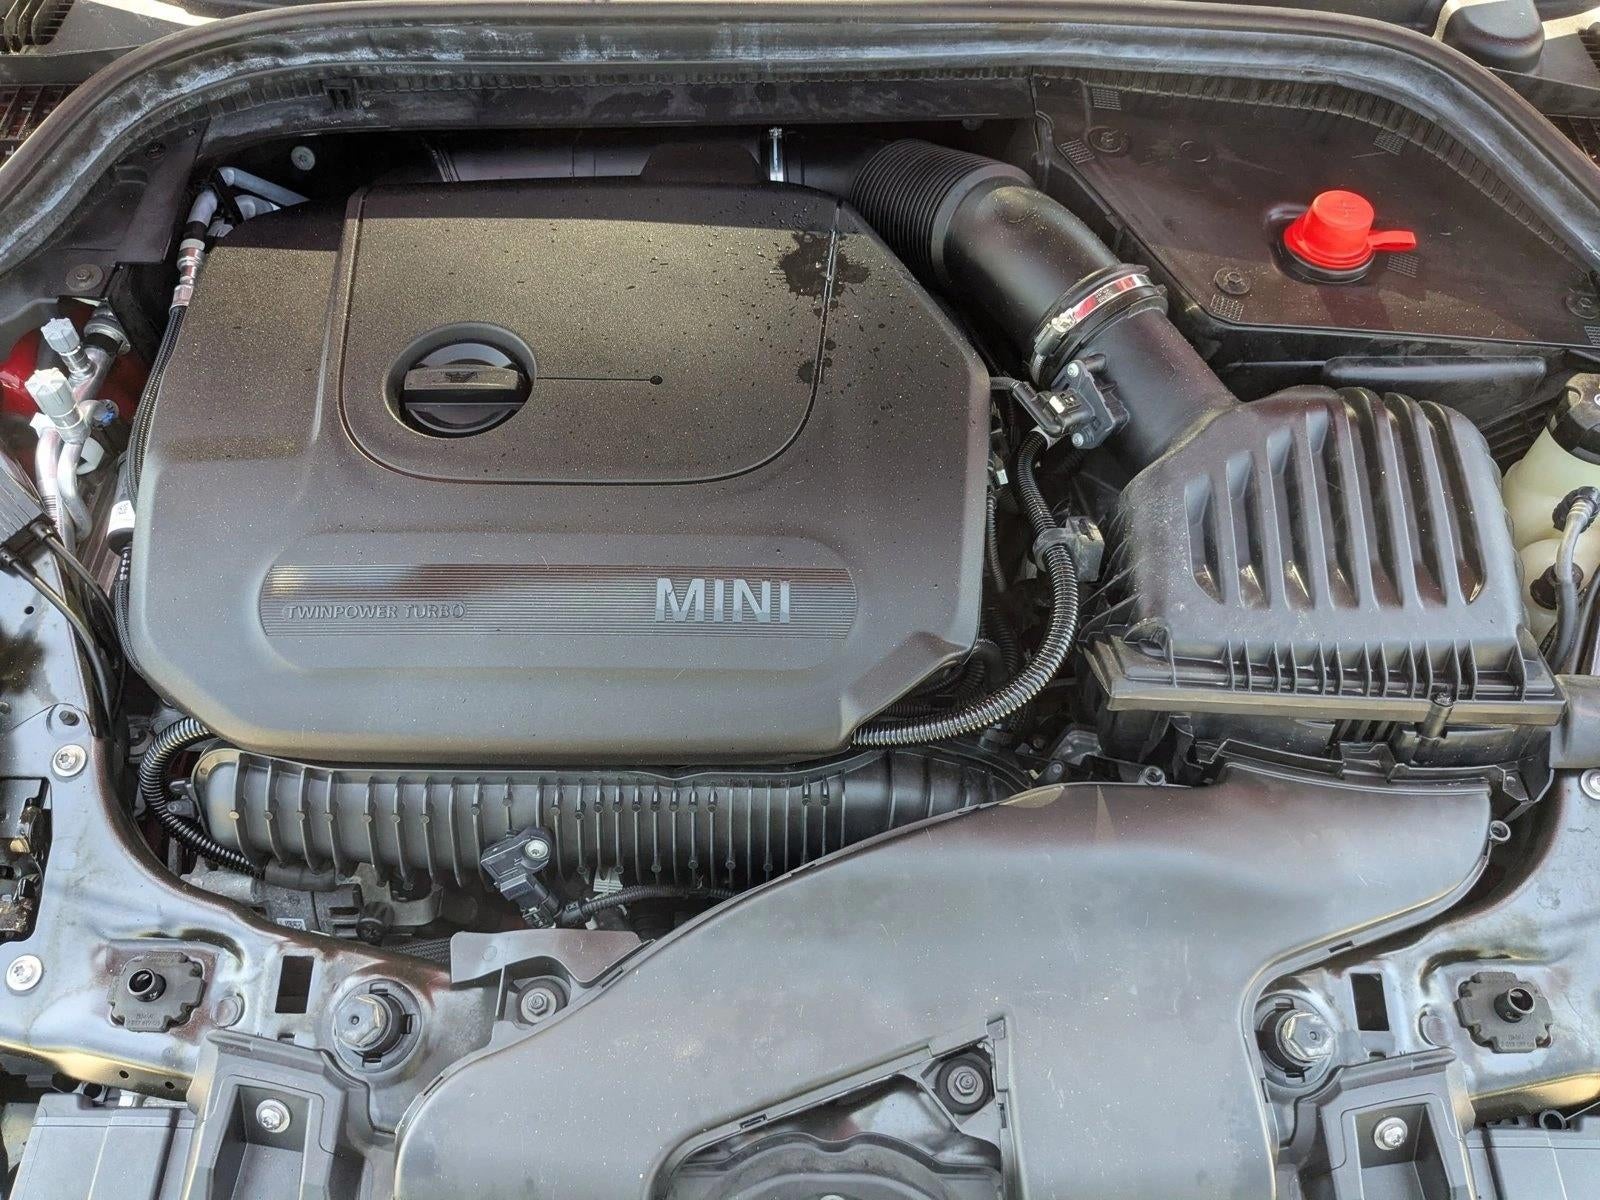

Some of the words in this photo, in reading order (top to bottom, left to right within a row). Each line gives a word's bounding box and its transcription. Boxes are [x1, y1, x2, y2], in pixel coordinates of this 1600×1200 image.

[286, 604, 398, 619] TWINPOWER
[403, 603, 465, 619] TURBO
[655, 577, 791, 623] MINI
